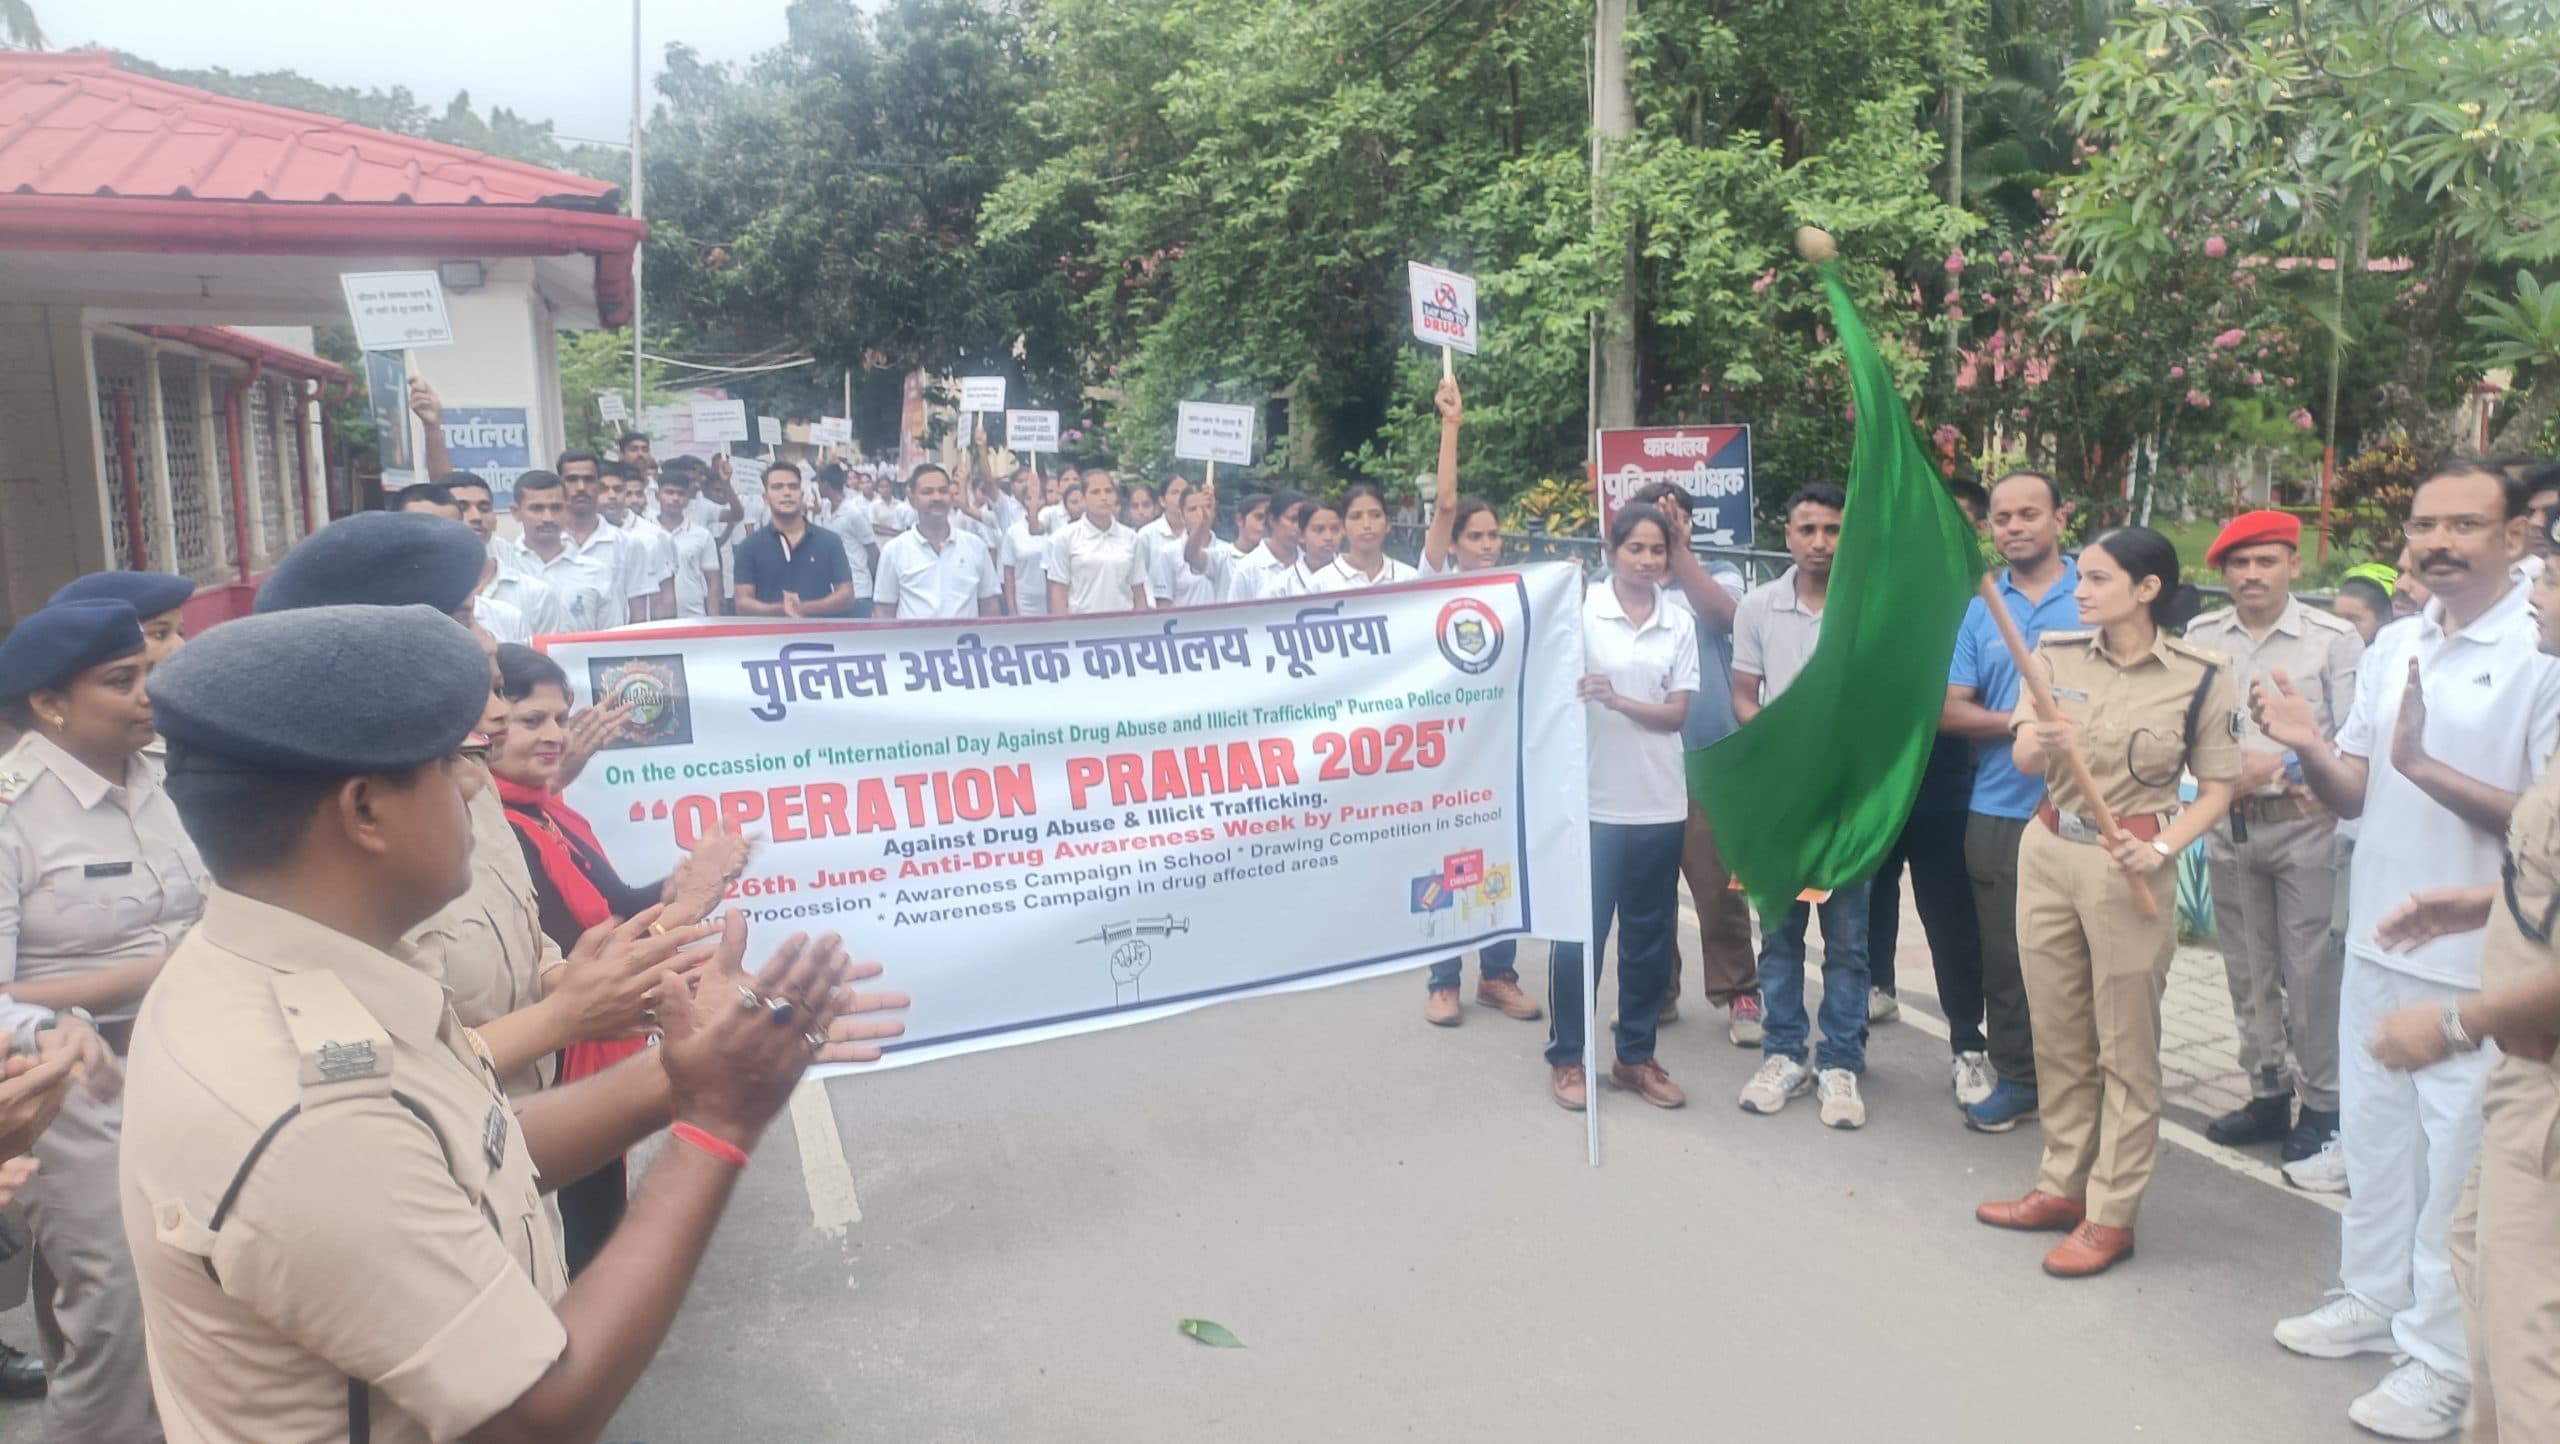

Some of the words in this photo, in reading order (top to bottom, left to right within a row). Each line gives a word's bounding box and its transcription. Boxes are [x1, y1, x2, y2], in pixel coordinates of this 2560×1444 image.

[1424, 316, 1465, 337] DRUGS
[1643, 431, 1709, 457] कार्यालय
[741, 643, 888, 722] पुलिस
[899, 633, 1071, 692] अधीक्षक
[1075, 619, 1251, 679] कार्यालय
[606, 765, 635, 785] On
[642, 763, 675, 782] the
[683, 753, 786, 779] occassion
[793, 749, 811, 768] of
[957, 735, 990, 756] Day
[996, 728, 1064, 752] Against
[1070, 725, 1110, 744] Drug
[1115, 719, 1167, 738] Abuse
[1173, 714, 1201, 732] and
[1207, 709, 1248, 729] Illicit
[1348, 696, 1403, 714] Purnea
[1407, 688, 1451, 708] Police
[1456, 684, 1504, 706] Operate
[1066, 738, 1299, 810] PRAHAR
[722, 875, 796, 899] 26th
[808, 867, 887, 889] June
[898, 848, 1044, 879] Anti-Drug
[1054, 826, 1215, 860] Awareness
[1223, 814, 1295, 838] Week
[1304, 811, 1331, 829] by
[1340, 799, 1424, 822] Purnea
[1432, 788, 1494, 809] Police
[884, 830, 976, 857] Against
[984, 825, 1038, 846] Drug
[1046, 817, 1115, 837] Abuse
[1124, 811, 1140, 828] &
[1148, 803, 1205, 826] Illicit
[1210, 791, 1328, 817] Trafficking.
[895, 876, 1017, 905] Awareness
[1024, 863, 1132, 889] Campaign
[1138, 859, 1157, 874] in
[1164, 848, 1231, 870] School
[1251, 836, 1323, 858] Drawing
[1330, 822, 1431, 846] Competition
[1436, 817, 1450, 830] in
[1454, 807, 1502, 828] School
[893, 899, 1016, 927] Awareness
[1023, 883, 1130, 910] Campaign
[1138, 879, 1155, 894] in
[1162, 872, 1206, 891] drug
[1213, 860, 1285, 883] affected
[1291, 853, 1339, 871] areas
